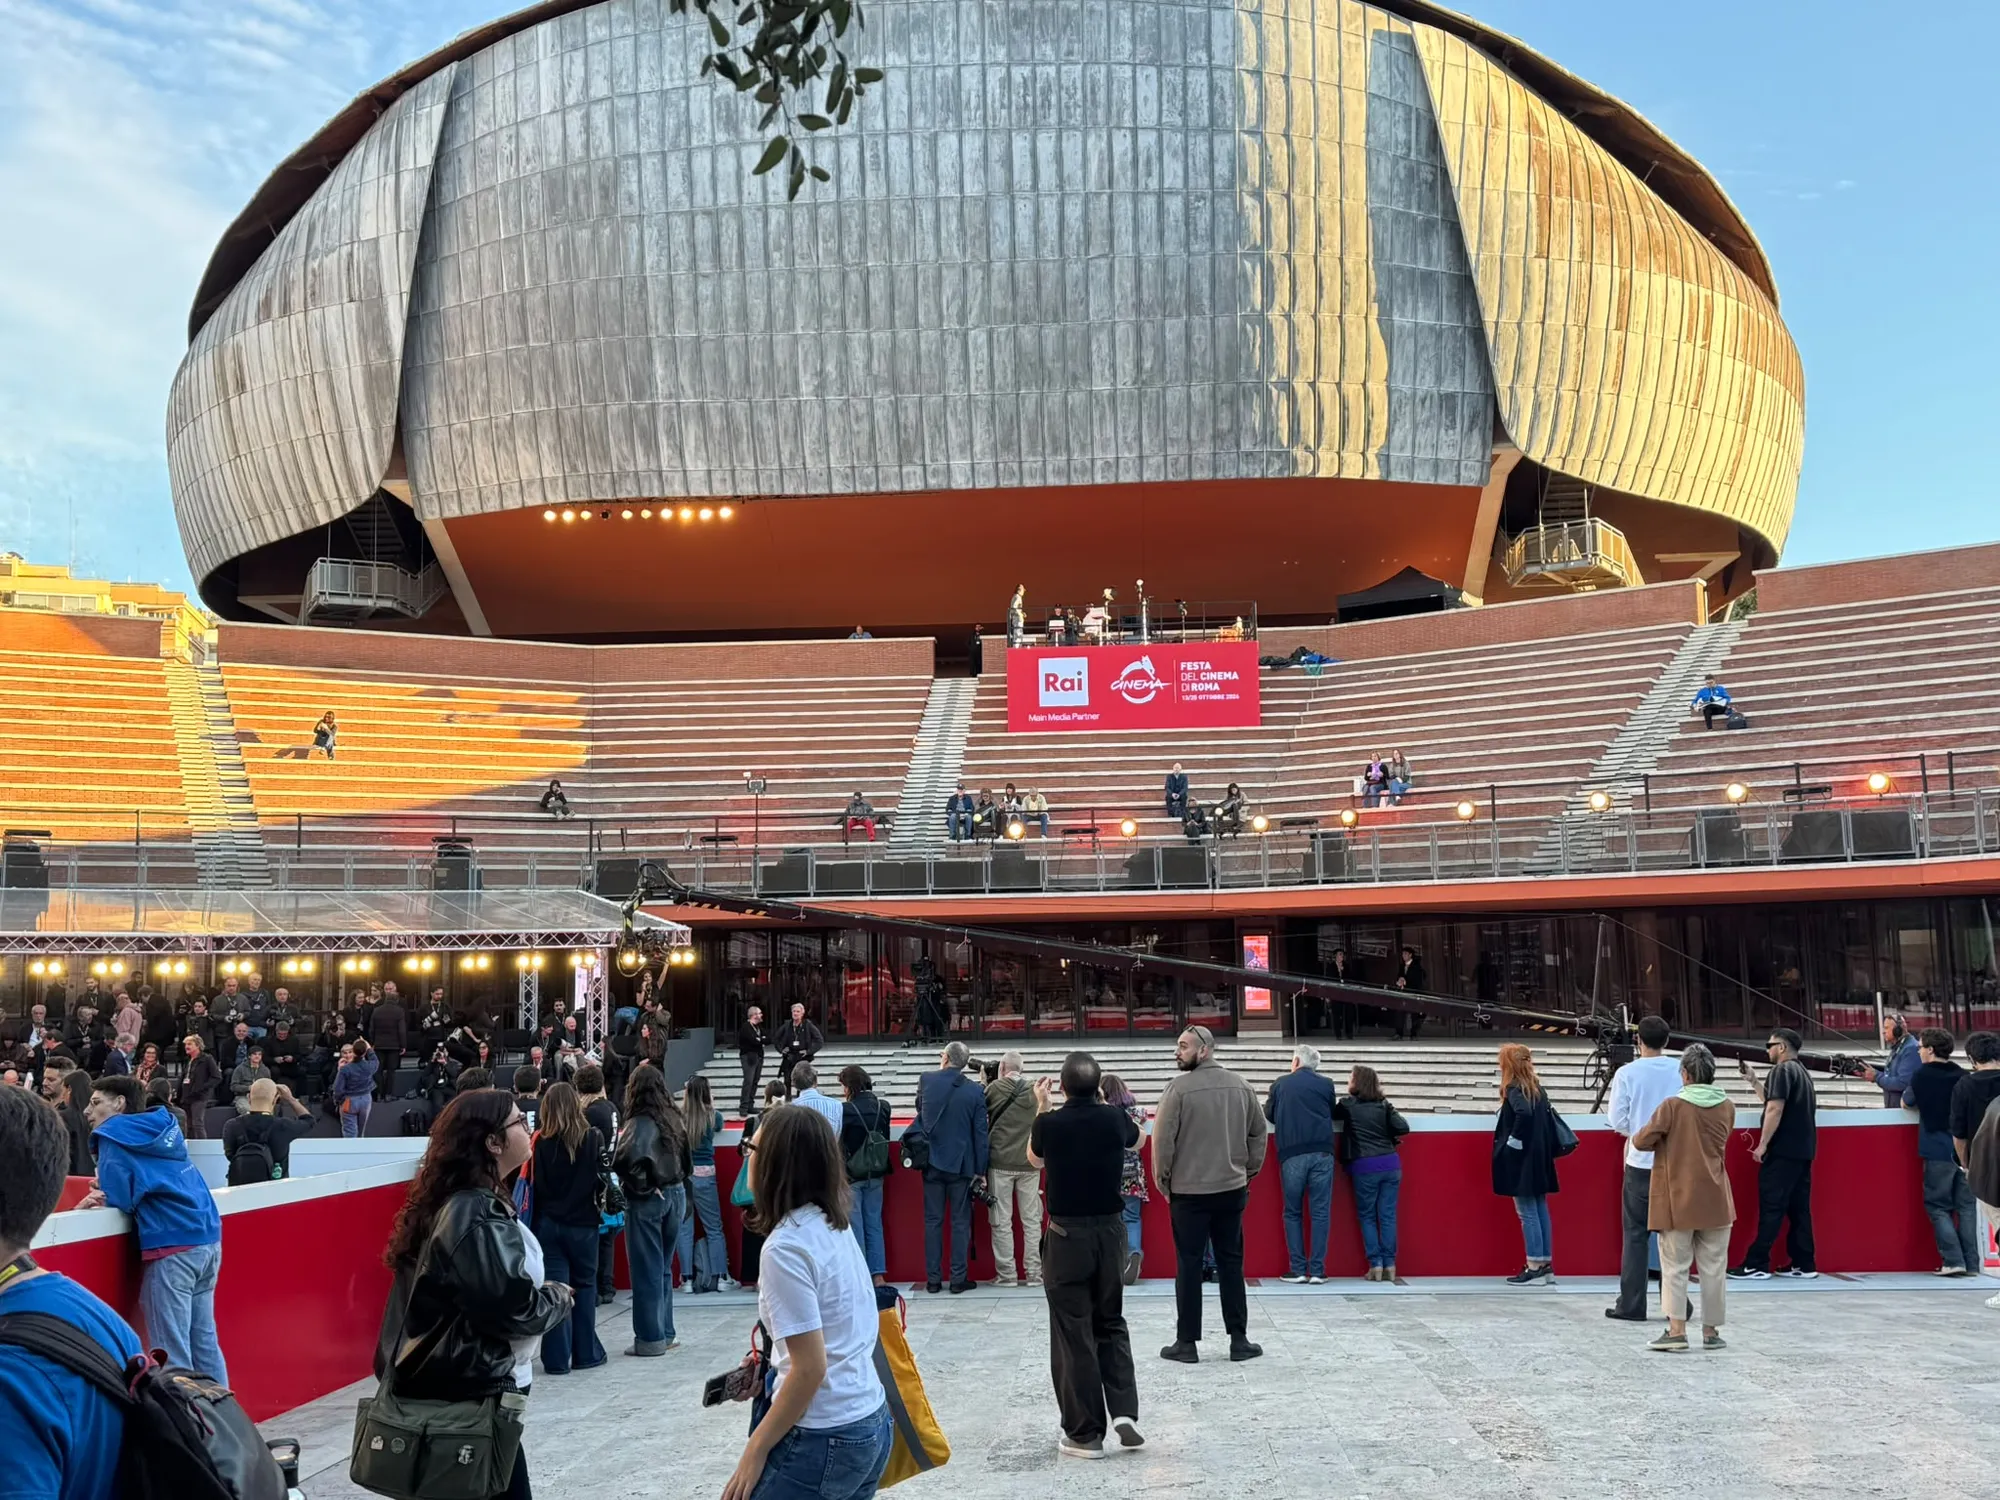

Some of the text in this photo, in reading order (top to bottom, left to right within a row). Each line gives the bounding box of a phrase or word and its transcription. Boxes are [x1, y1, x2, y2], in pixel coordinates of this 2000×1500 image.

[1180, 661, 1212, 671] FESTA
[1181, 671, 1239, 681] DEL CINEMA
[1044, 671, 1083, 692] Rai
[1110, 678, 1172, 691] CINEMA
[1181, 682, 1220, 692] DI ROMA
[1028, 712, 1100, 722] Main Media Partner
